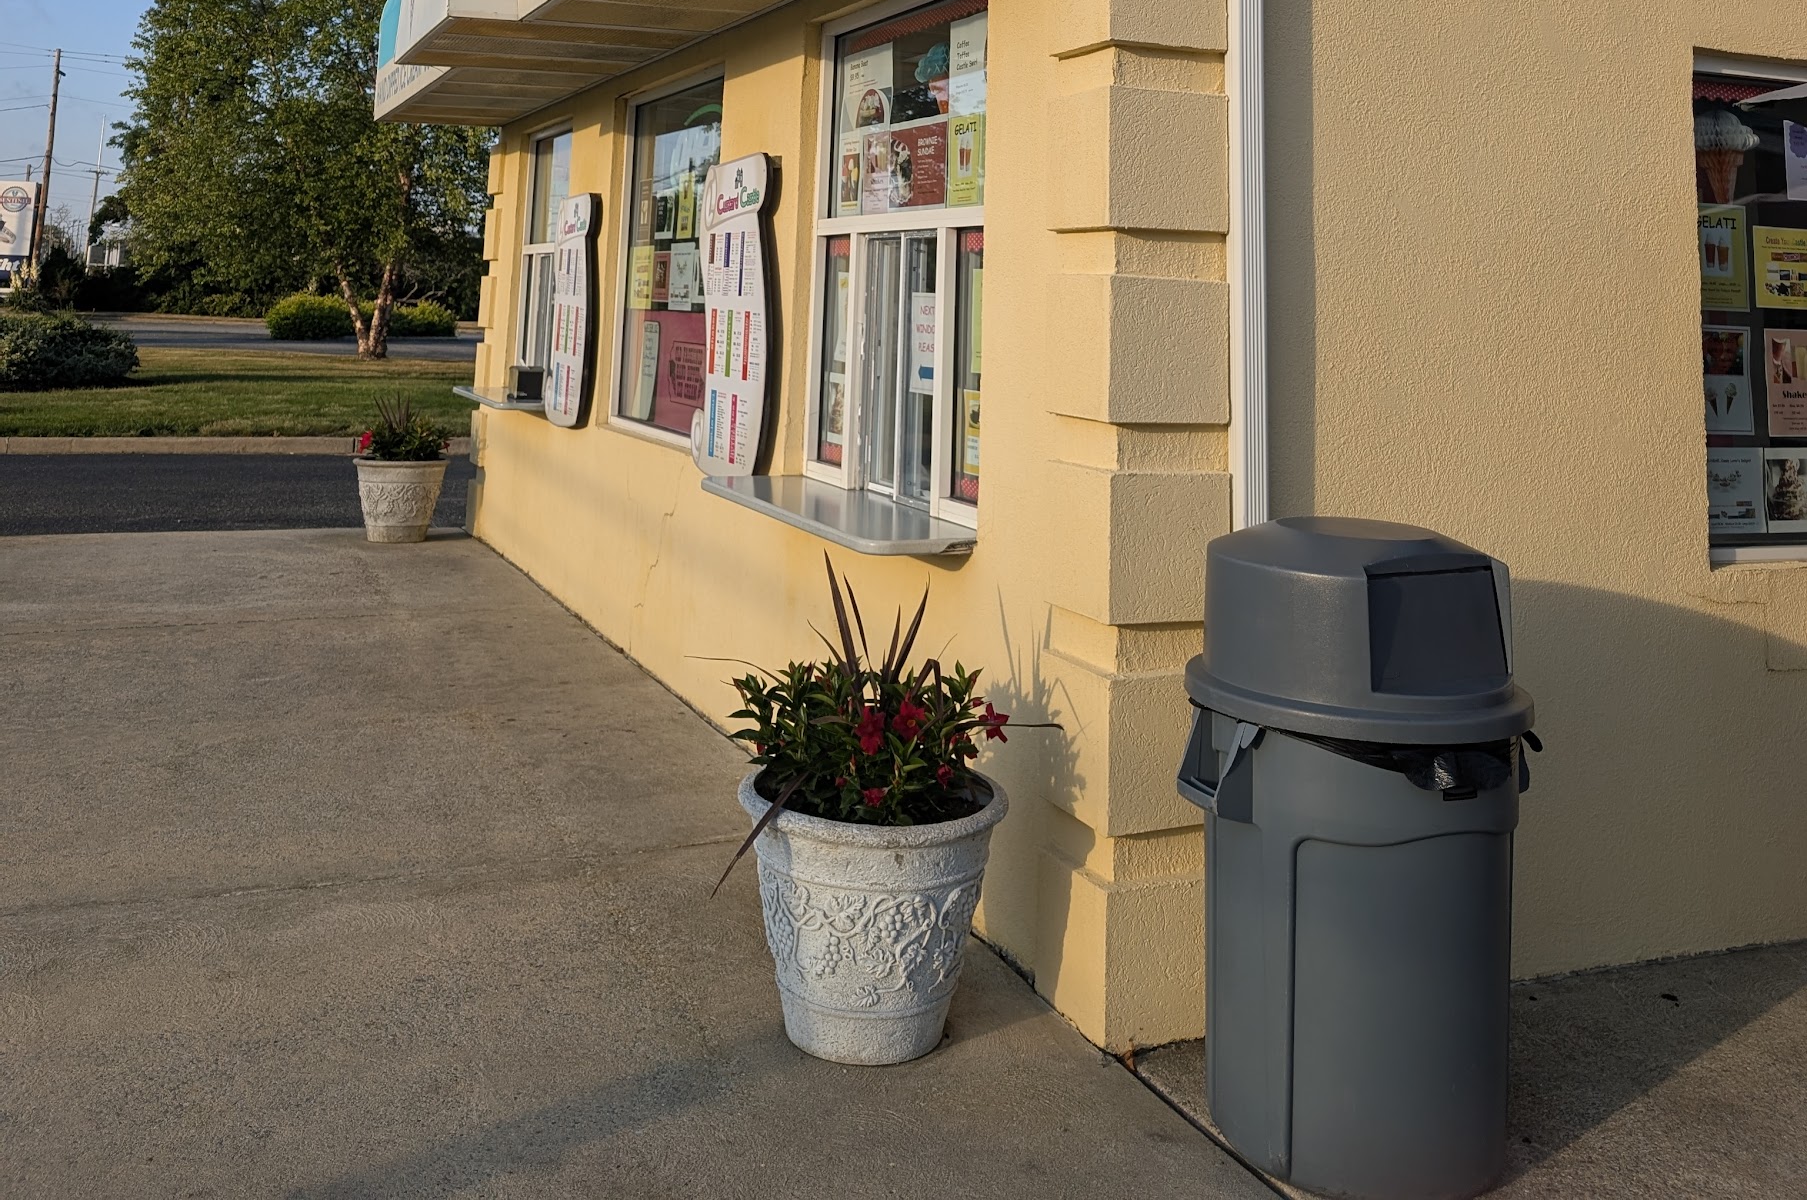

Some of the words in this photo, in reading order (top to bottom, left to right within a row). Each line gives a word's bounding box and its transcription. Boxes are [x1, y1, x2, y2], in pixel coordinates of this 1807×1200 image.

[954, 121, 977, 136] GELATI
[717, 192, 739, 215] Custard
[740, 186, 760, 208] Castle
[0, 258, 20, 272] ht
[915, 323, 935, 335] WINDO
